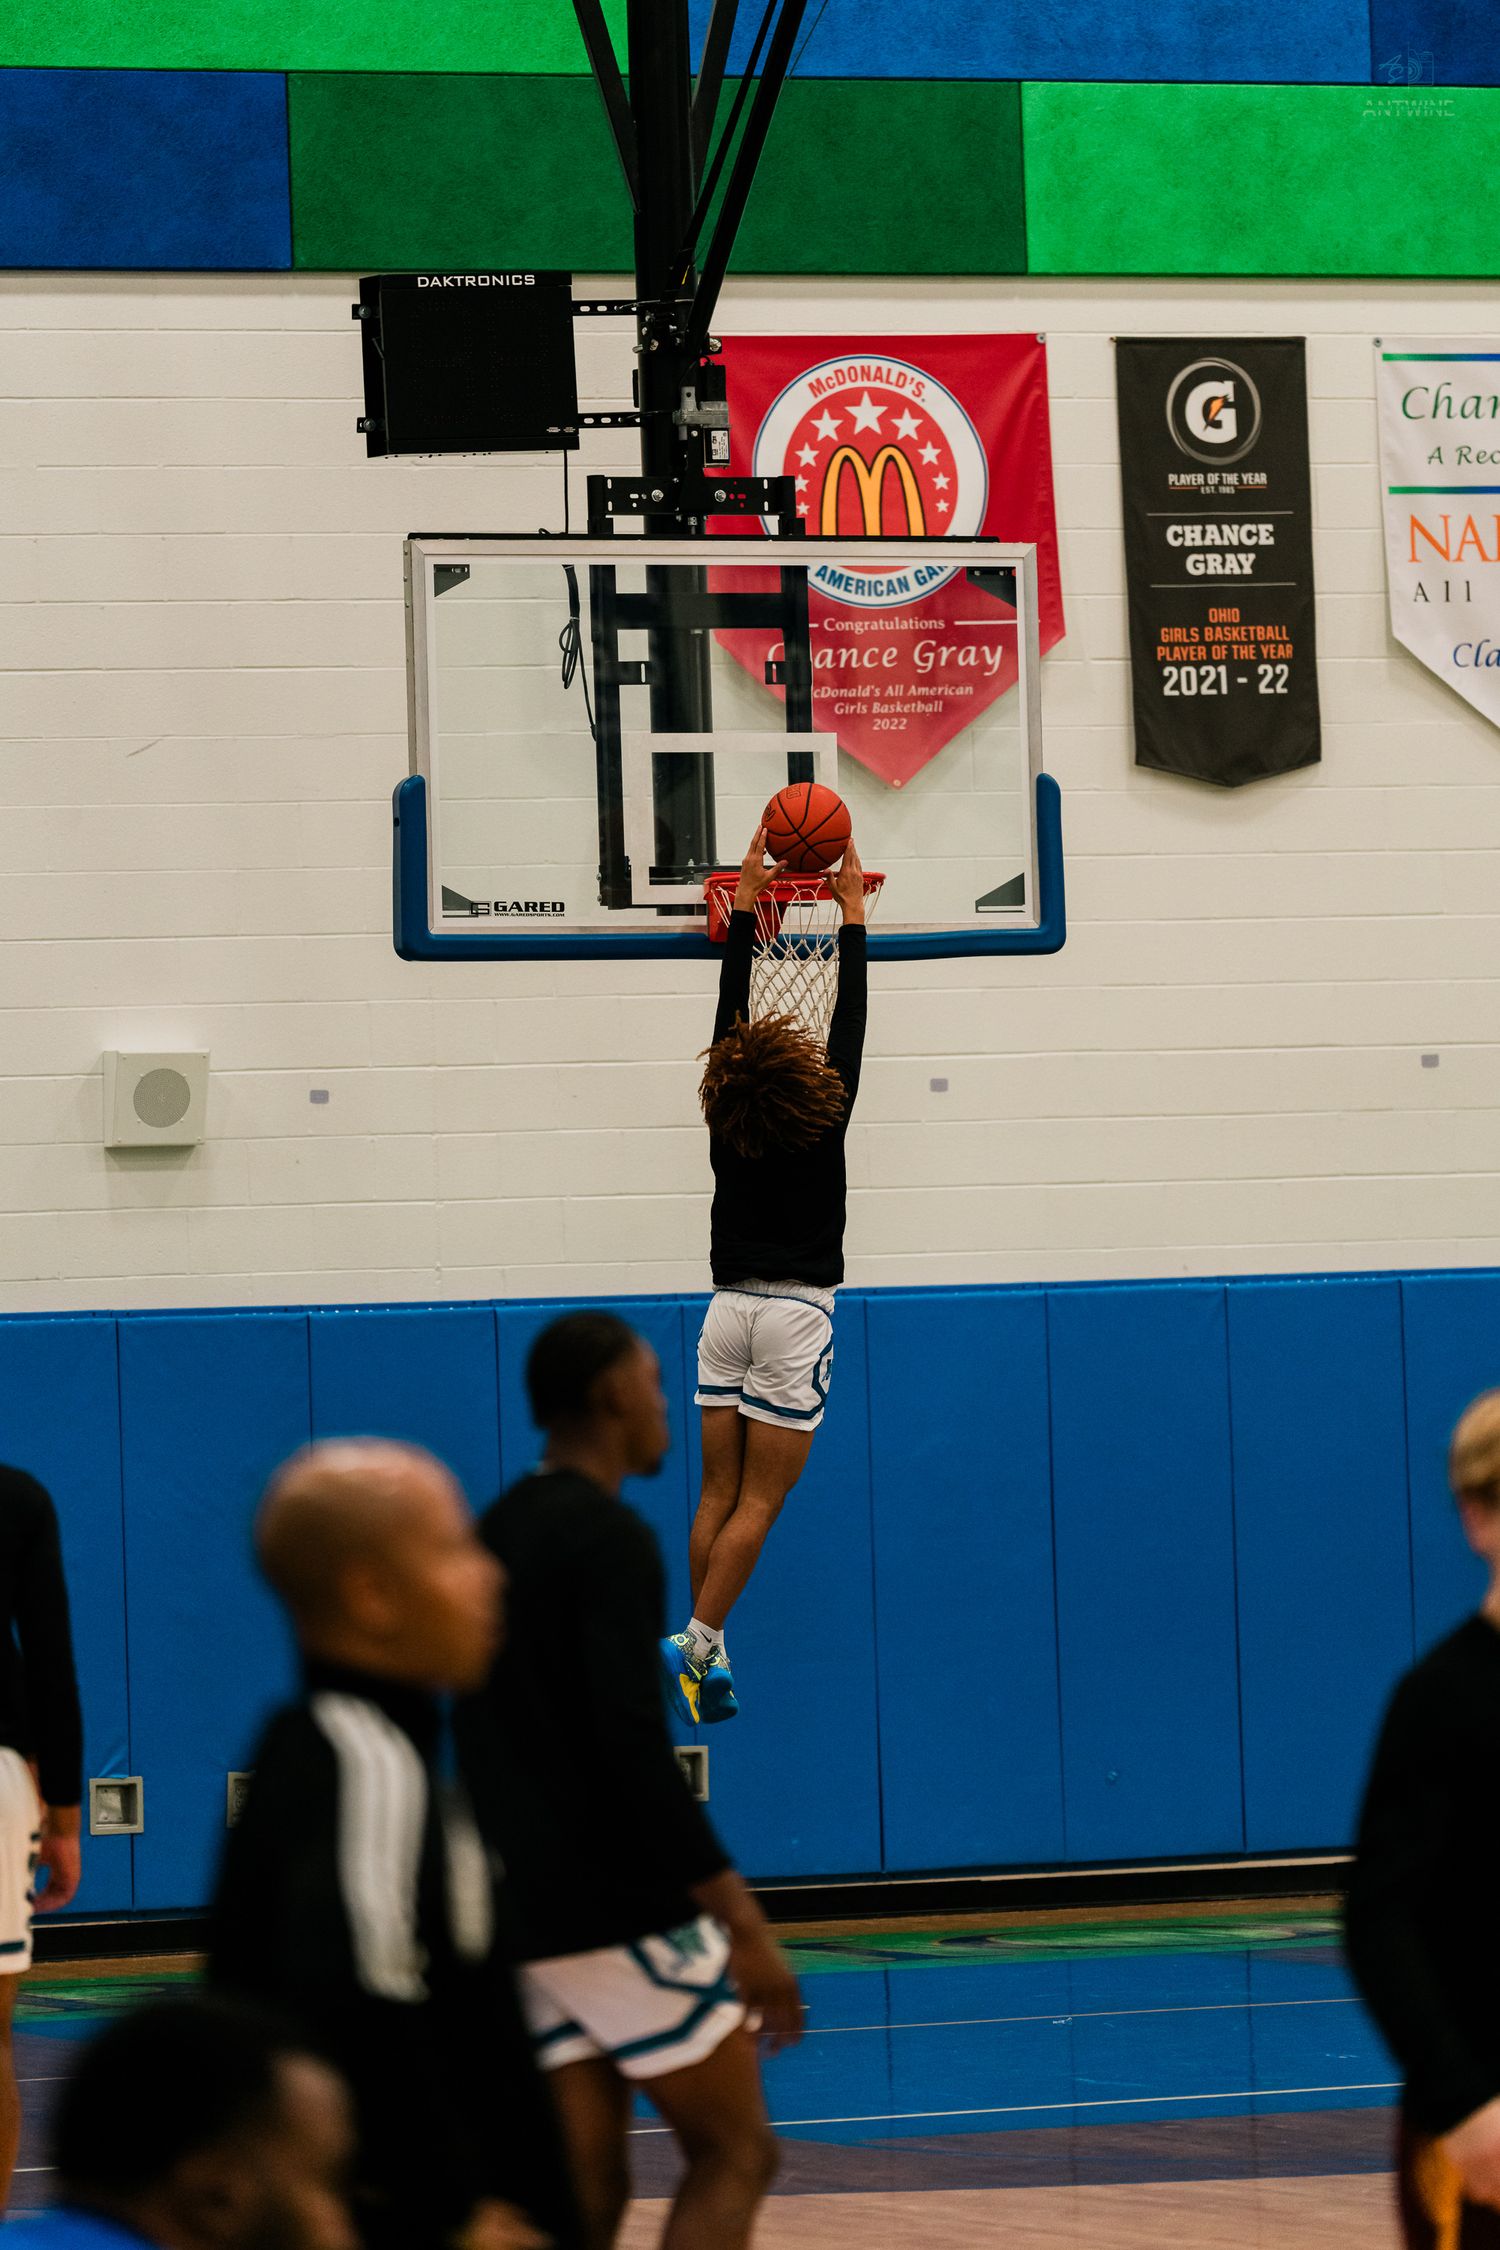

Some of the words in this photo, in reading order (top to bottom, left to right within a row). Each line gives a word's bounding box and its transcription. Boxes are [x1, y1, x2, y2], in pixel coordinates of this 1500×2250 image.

[417, 274, 536, 288] DAKTRONICS
[808, 365, 926, 399] McDONALD'S
[1428, 446, 1444, 465] A
[1168, 473, 1204, 486] PLAYER
[1207, 473, 1221, 485] OF
[1222, 473, 1239, 485] THE
[1241, 472, 1268, 485] YEAR
[1166, 524, 1275, 547] CHANCE
[1185, 553, 1257, 576] GRAY
[815, 566, 910, 597] AMERICAN
[1413, 580, 1472, 603] All
[1208, 607, 1241, 623] OHIO
[823, 617, 945, 635] Congratulations
[1160, 627, 1199, 643] GIRLS
[1204, 626, 1289, 642] BASKETBALL
[913, 640, 1003, 677] Gray
[1157, 645, 1207, 661] PLAYER
[1212, 645, 1229, 660] OF
[1232, 644, 1256, 659] THE
[1260, 644, 1293, 659] YEAR
[1162, 665, 1228, 696] 2021
[1257, 664, 1289, 694] 22
[813, 685, 880, 699] cDonald's
[885, 685, 903, 697] All
[907, 685, 973, 697] American
[834, 702, 867, 715] Girls
[872, 701, 943, 714] Basketball
[872, 718, 907, 730] 2022
[494, 901, 565, 912] GARED
